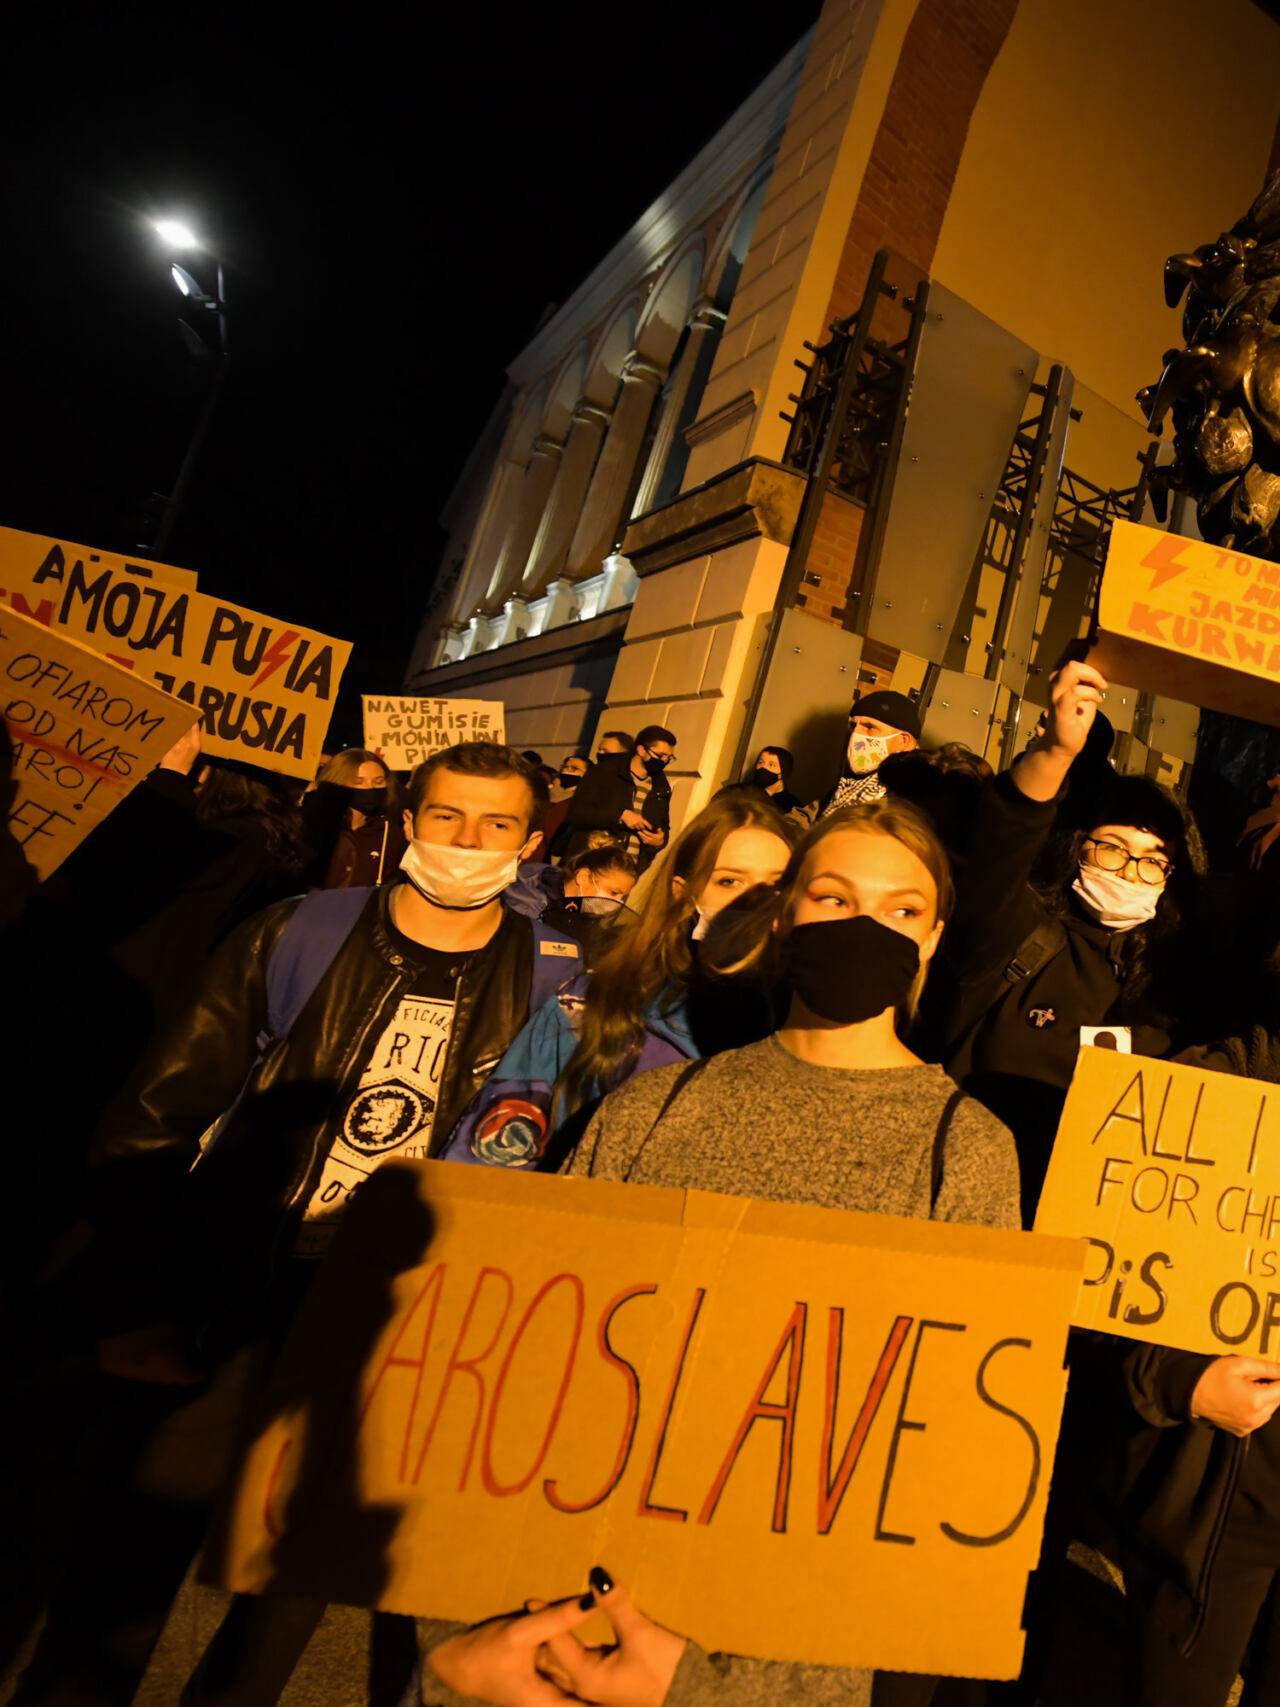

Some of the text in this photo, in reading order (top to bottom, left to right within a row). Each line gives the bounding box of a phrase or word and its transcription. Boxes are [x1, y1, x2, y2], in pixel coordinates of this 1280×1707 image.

[1212, 549, 1252, 577] TO
[58, 559, 189, 657] MOJA
[6, 653, 164, 742] OFIAROM
[367, 701, 448, 714] NAWET
[4, 700, 138, 776] OD NAS
[1092, 1070, 1216, 1166] ALL
[1247, 1095, 1266, 1173] I
[1096, 1157, 1200, 1224] FOR
[1244, 1249, 1277, 1277] IS
